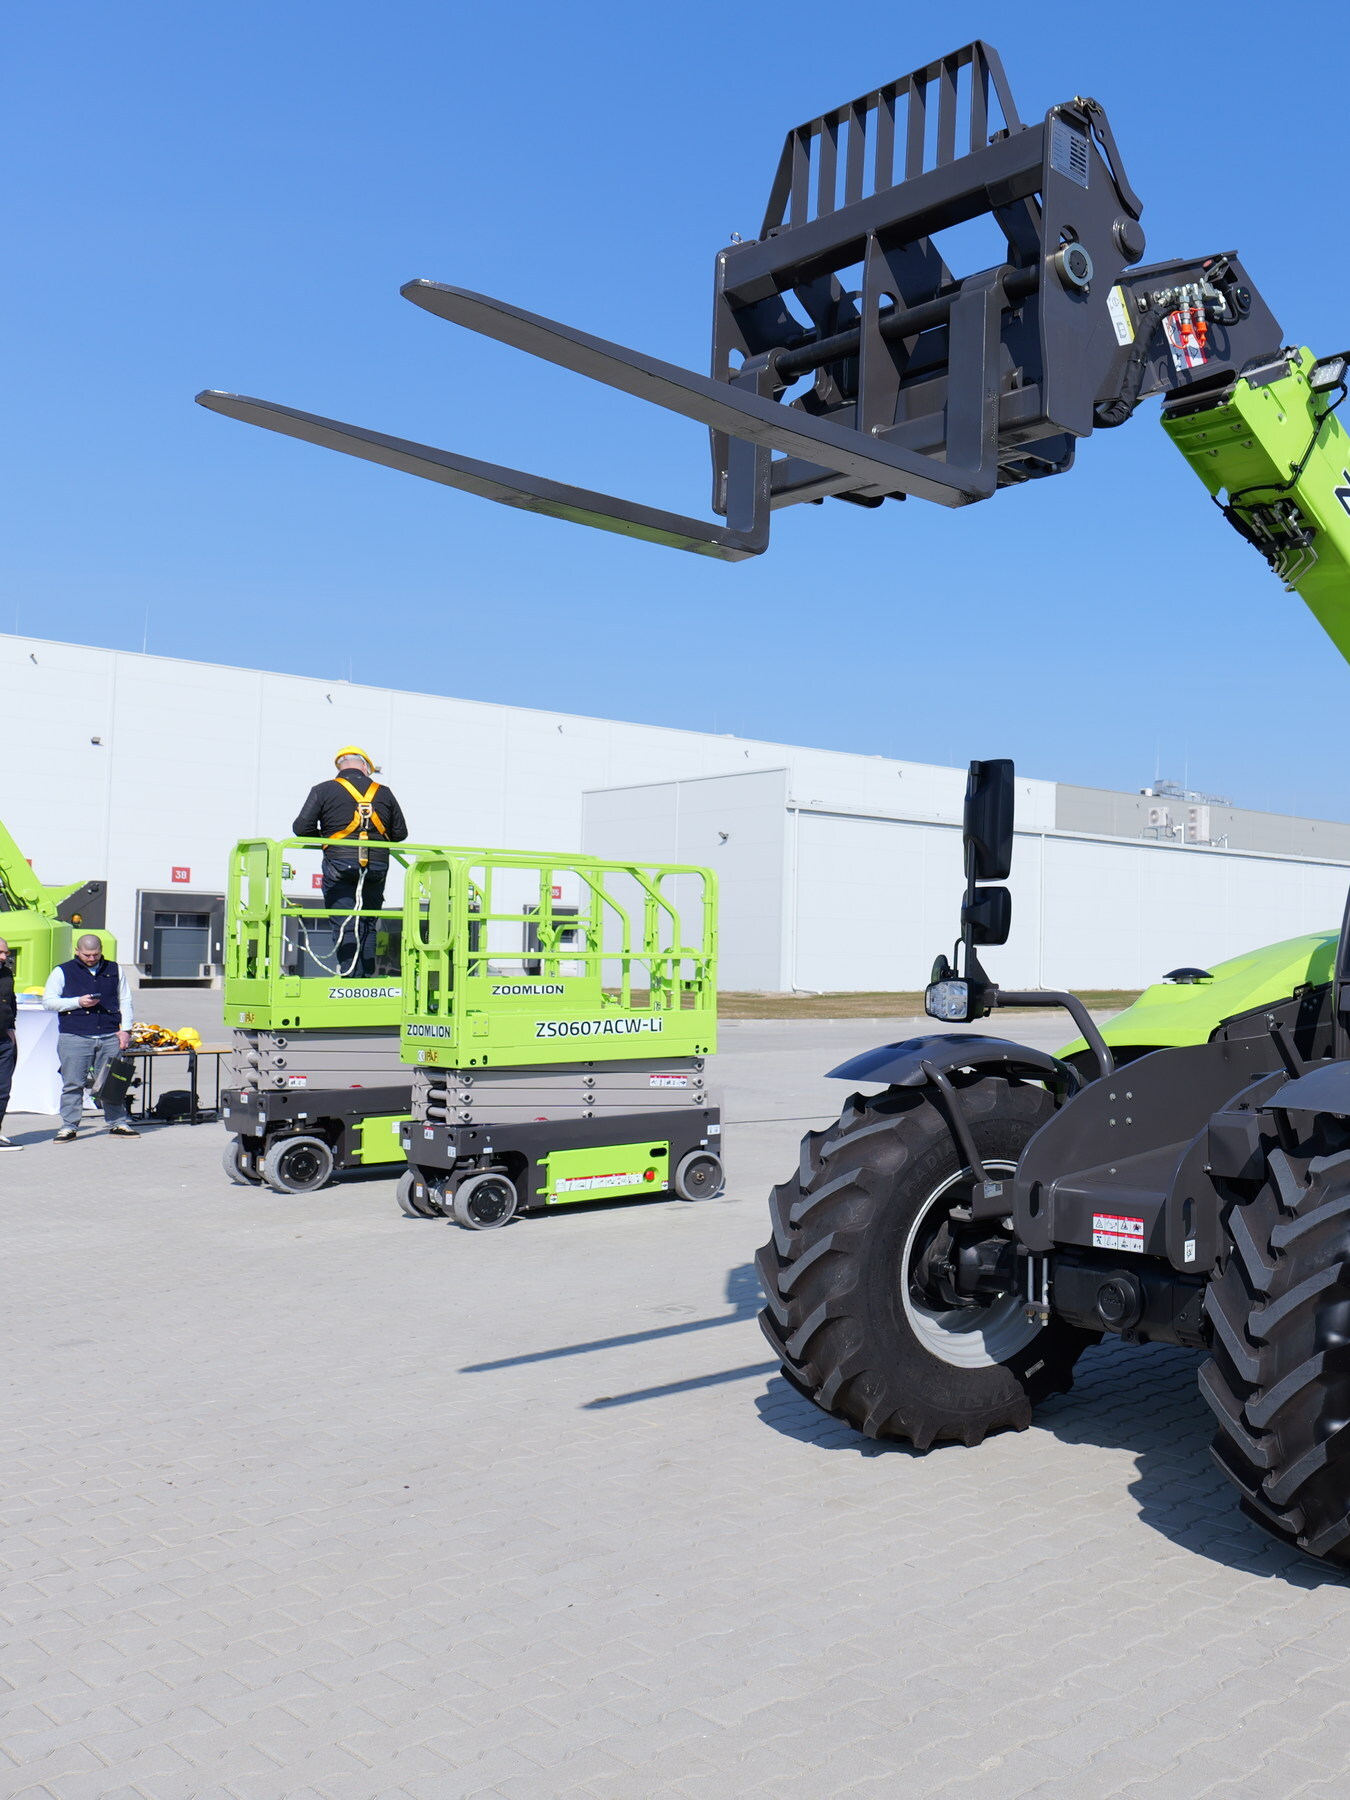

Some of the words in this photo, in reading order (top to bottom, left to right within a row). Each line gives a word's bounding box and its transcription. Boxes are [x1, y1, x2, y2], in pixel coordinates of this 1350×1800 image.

[175, 870, 187, 880] 38
[329, 987, 400, 999] ZS0808AC-
[491, 985, 564, 995] ZOOMLION
[407, 1024, 450, 1038] ZOOMLION
[536, 1017, 662, 1038] ZS0607ACW-Li
